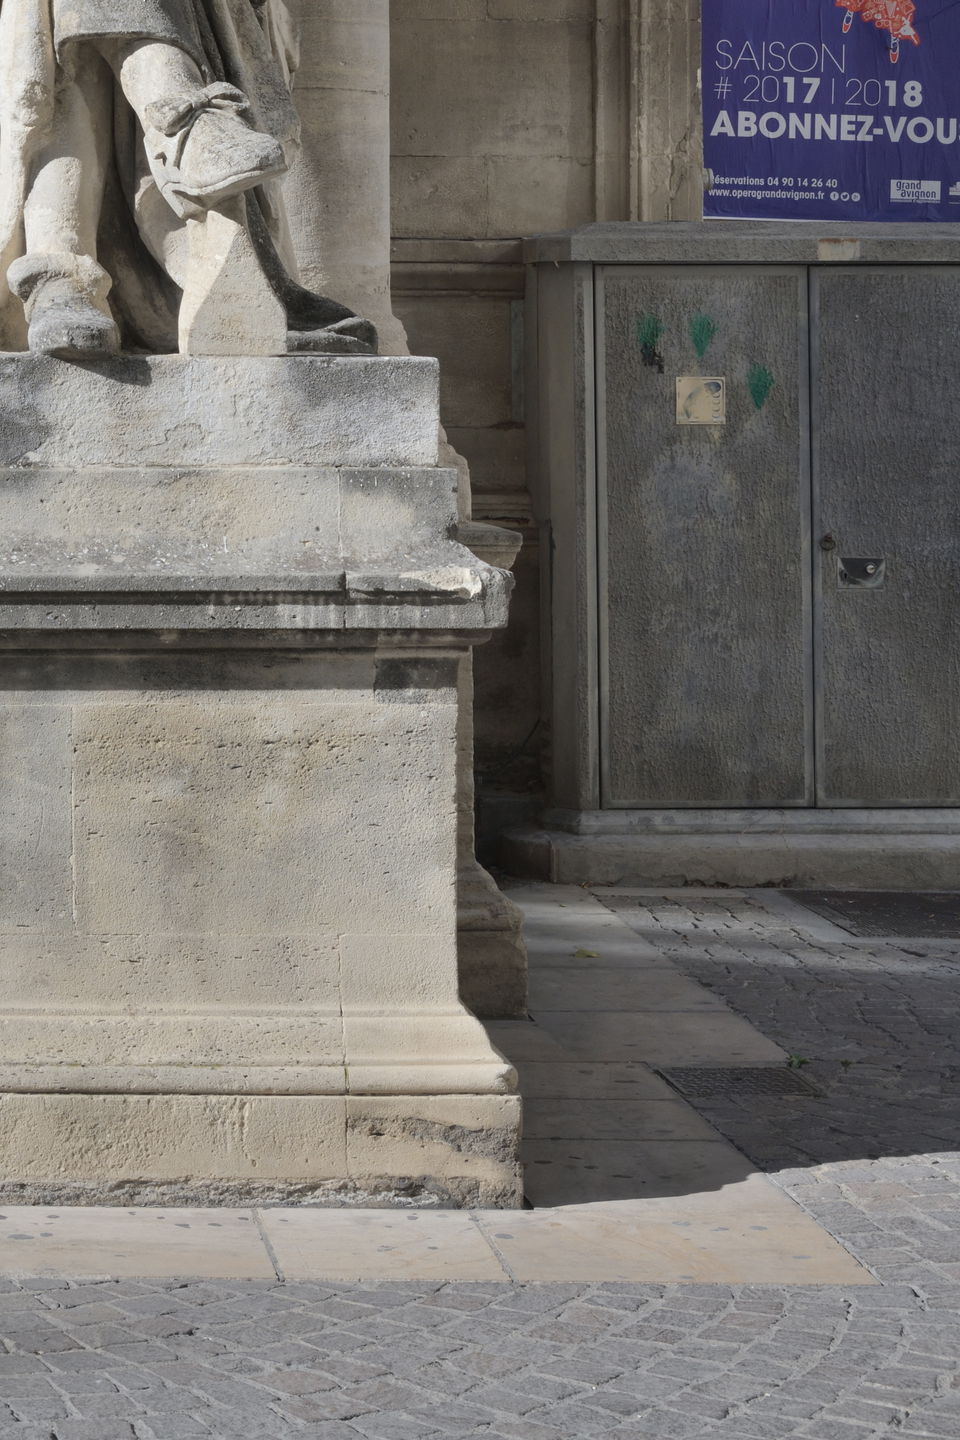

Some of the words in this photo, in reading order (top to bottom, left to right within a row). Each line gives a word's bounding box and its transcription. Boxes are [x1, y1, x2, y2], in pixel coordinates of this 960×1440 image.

[715, 39, 845, 73] SAISON
[743, 75, 821, 104] 2017
[845, 78, 923, 108] 2018
[710, 110, 960, 145] ABONNEZ-VOU
[712, 175, 765, 186] éservations
[767, 177, 779, 187] 04
[782, 177, 794, 187] 90
[797, 178, 808, 187] 14
[811, 178, 823, 188] 26
[825, 179, 838, 188] 40
[895, 180, 922, 191] grand
[708, 189, 825, 201] www.operagrandavignon.fr
[900, 189, 937, 200] avignon
